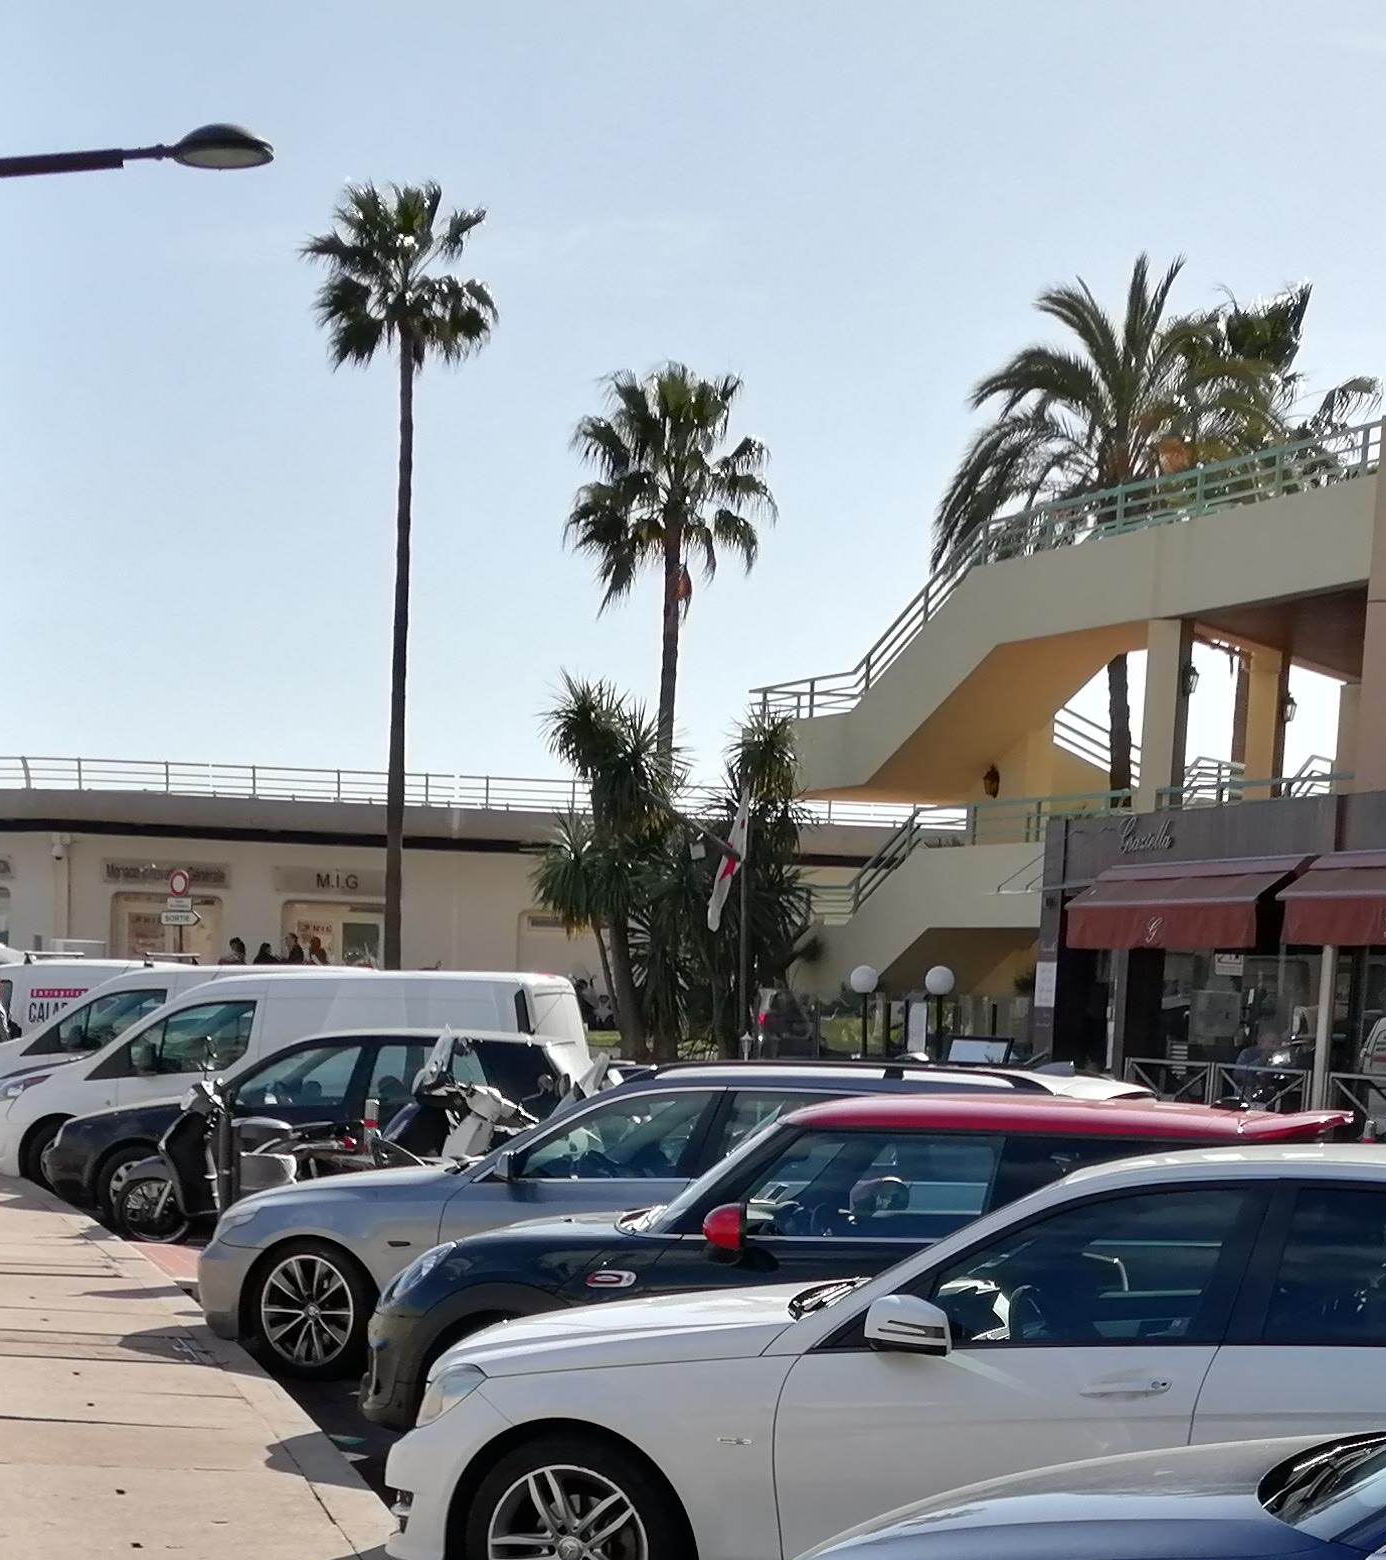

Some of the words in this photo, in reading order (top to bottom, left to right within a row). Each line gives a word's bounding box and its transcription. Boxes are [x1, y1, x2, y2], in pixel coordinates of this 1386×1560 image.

[316, 873, 359, 890] M.I.G
[165, 914, 190, 923] SORTIE
[28, 1002, 69, 1023] CALA
